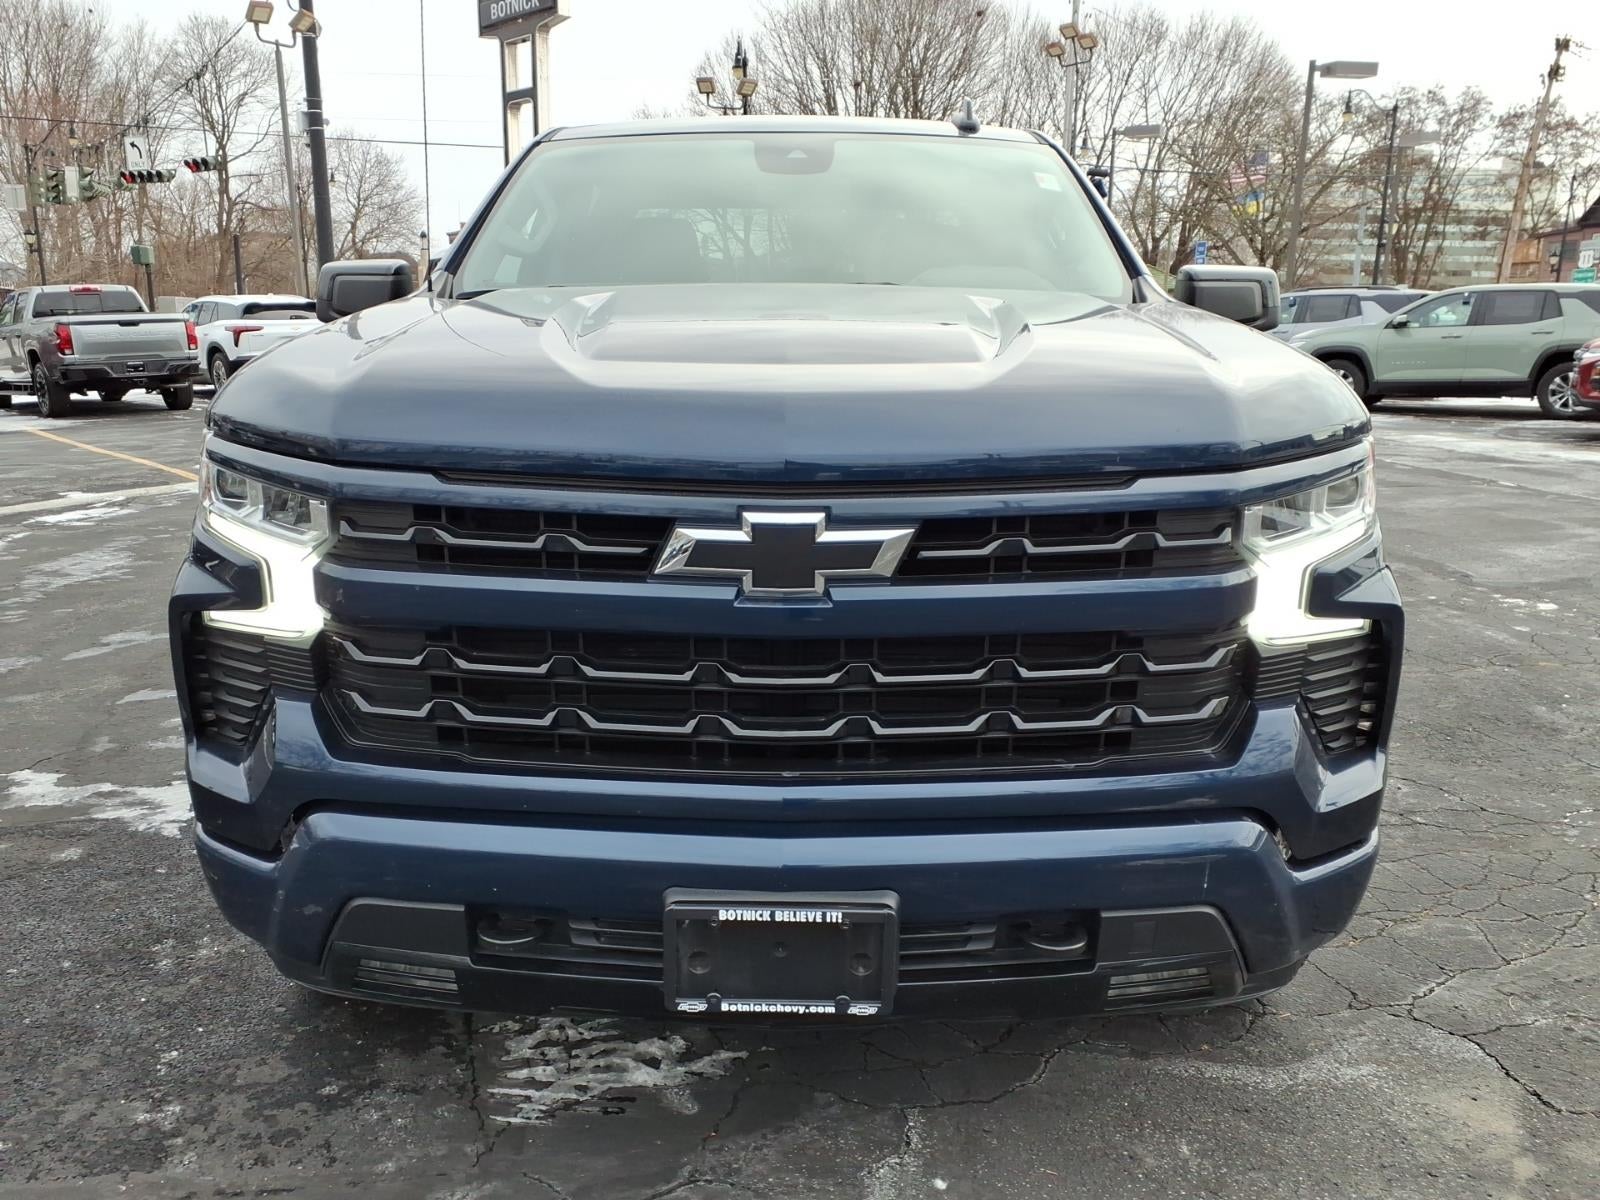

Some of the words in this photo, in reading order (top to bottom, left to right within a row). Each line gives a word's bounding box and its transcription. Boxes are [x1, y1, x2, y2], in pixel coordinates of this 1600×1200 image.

[719, 910, 771, 921] BOTNICK
[775, 910, 823, 923] BELIEVE
[826, 911, 843, 923] IT!
